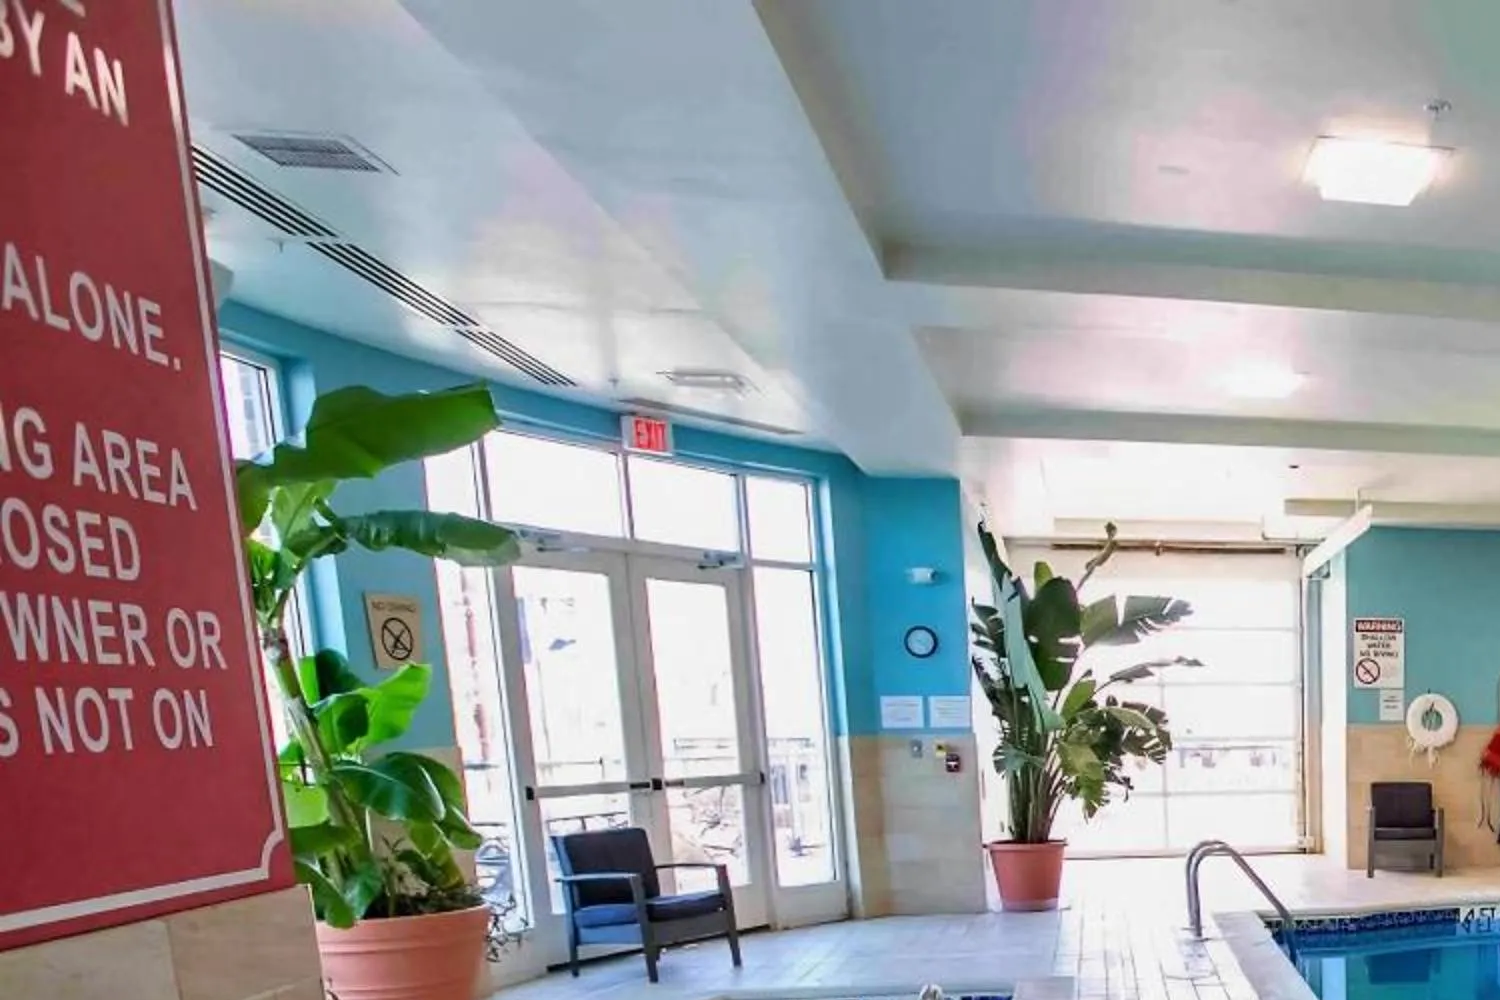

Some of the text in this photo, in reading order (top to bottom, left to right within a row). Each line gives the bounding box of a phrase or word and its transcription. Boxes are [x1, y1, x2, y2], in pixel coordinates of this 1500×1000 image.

[65, 31, 129, 128] AN
[2, 242, 182, 371] ALONE.
[72, 421, 198, 511] AREA
[166, 606, 228, 670] OR
[34, 686, 134, 754] NOT
[152, 687, 214, 750] ON
